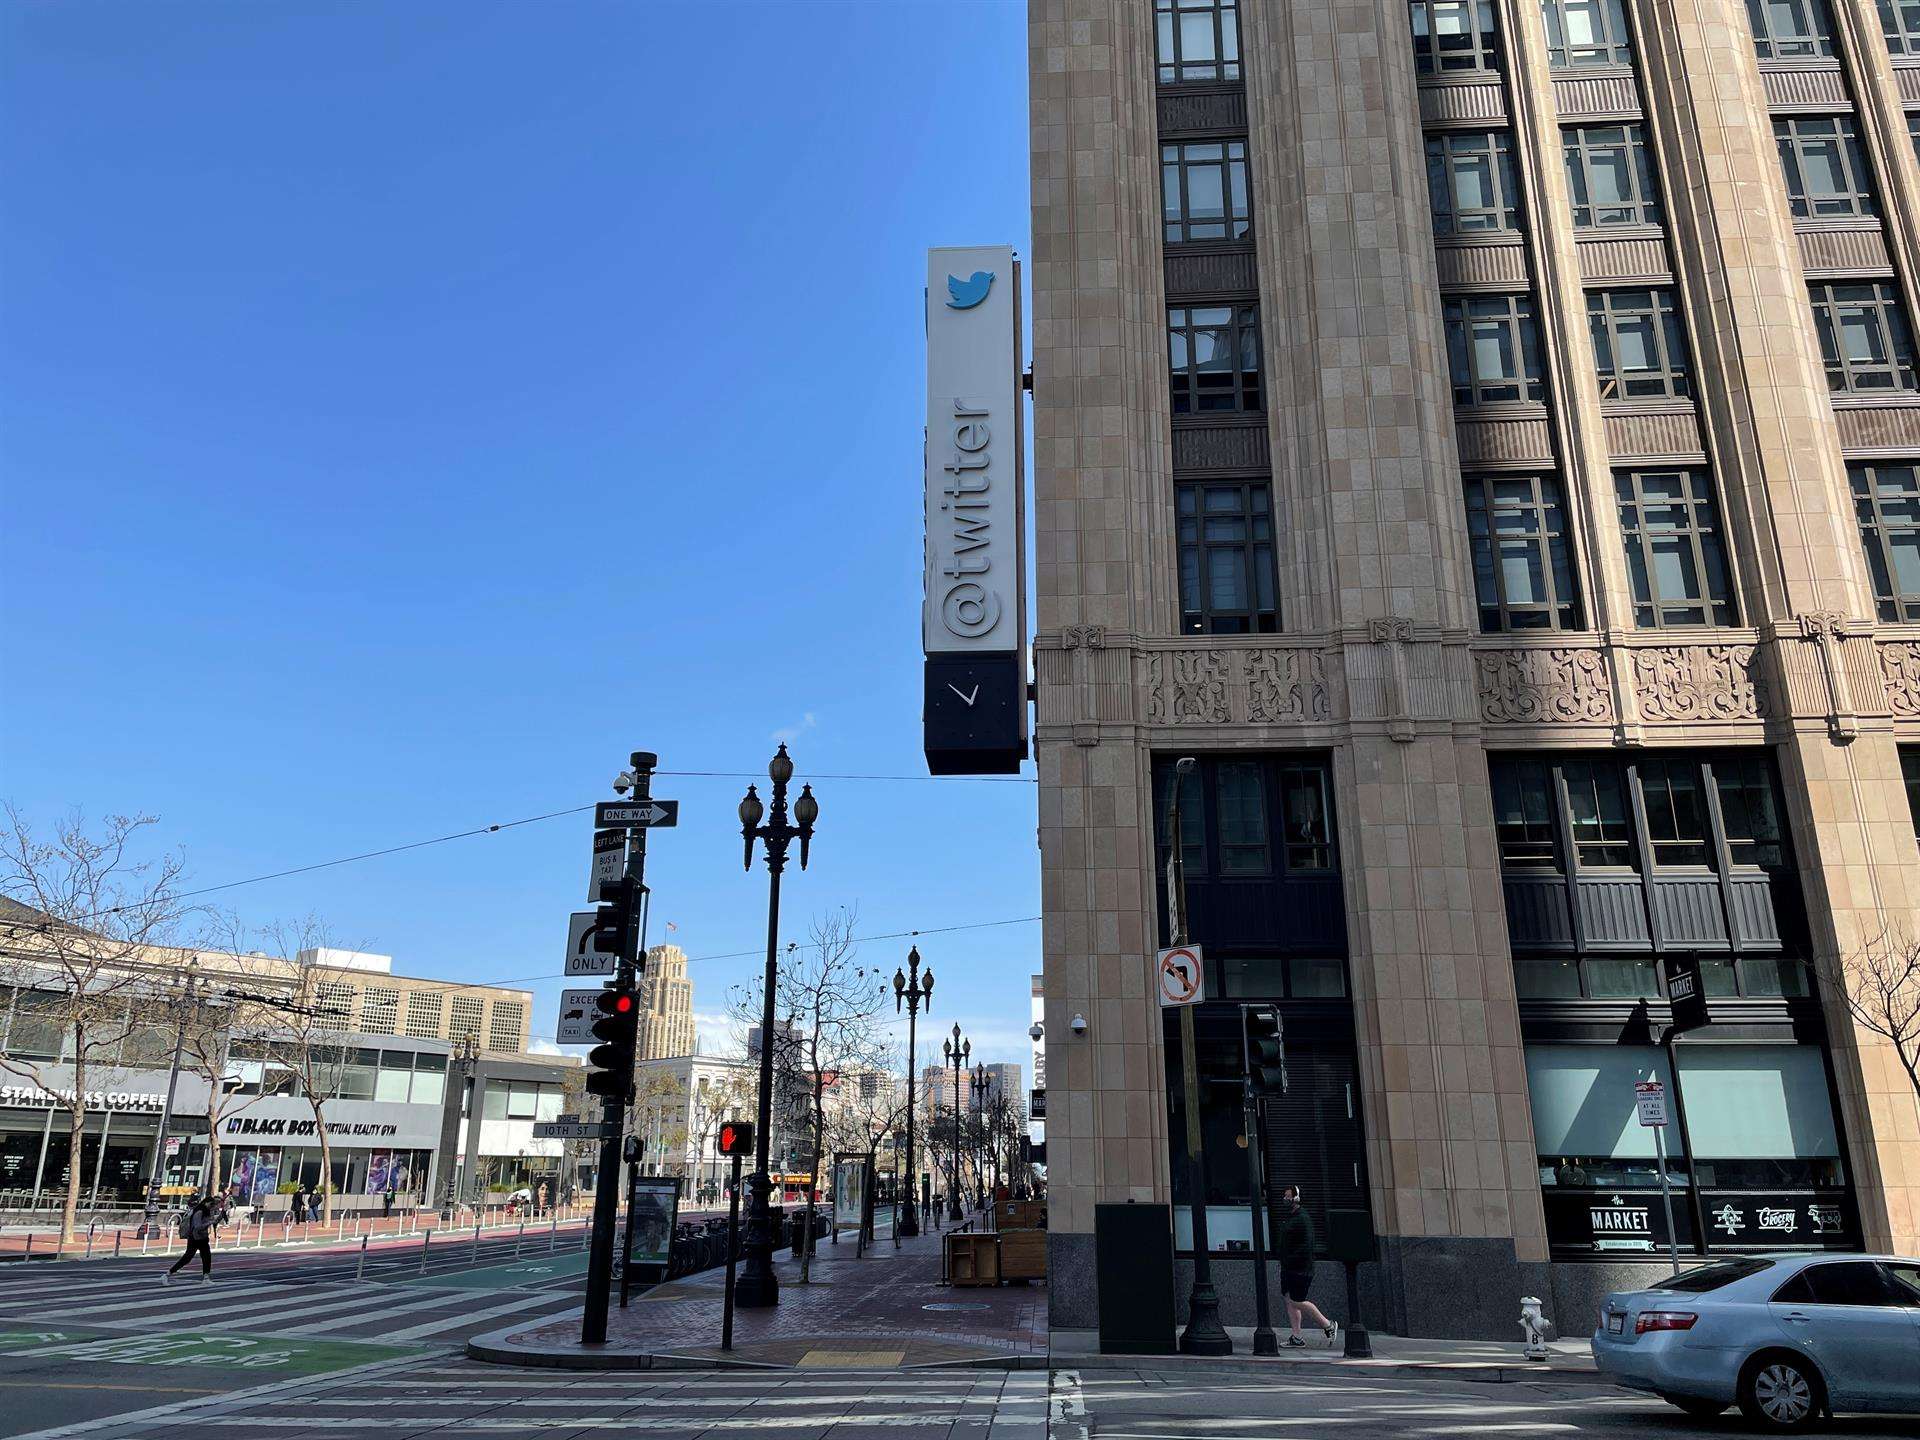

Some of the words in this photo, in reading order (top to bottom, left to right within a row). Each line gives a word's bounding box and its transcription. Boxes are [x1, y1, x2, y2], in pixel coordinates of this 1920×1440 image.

[942, 397, 1000, 638] @twitter
[606, 810, 626, 820] ONE
[631, 810, 652, 819] WAY
[609, 835, 624, 845] LANE
[600, 856, 611, 865] BUS
[601, 866, 614, 875] TAXI
[572, 958, 608, 970] ONLY
[1670, 976, 1693, 998] MARKET
[570, 995, 598, 1005] EXCEP
[564, 1028, 579, 1036] TAXI
[107, 1091, 168, 1106] COFFEE
[241, 1118, 287, 1135] BLACK
[287, 1119, 317, 1136] BOX
[352, 1123, 381, 1136] REALITY
[381, 1124, 397, 1136] GYM
[544, 1126, 569, 1136] 10TH
[576, 1126, 589, 1135] ST
[1611, 1194, 1624, 1205] the
[1591, 1211, 1648, 1230] MARKET
